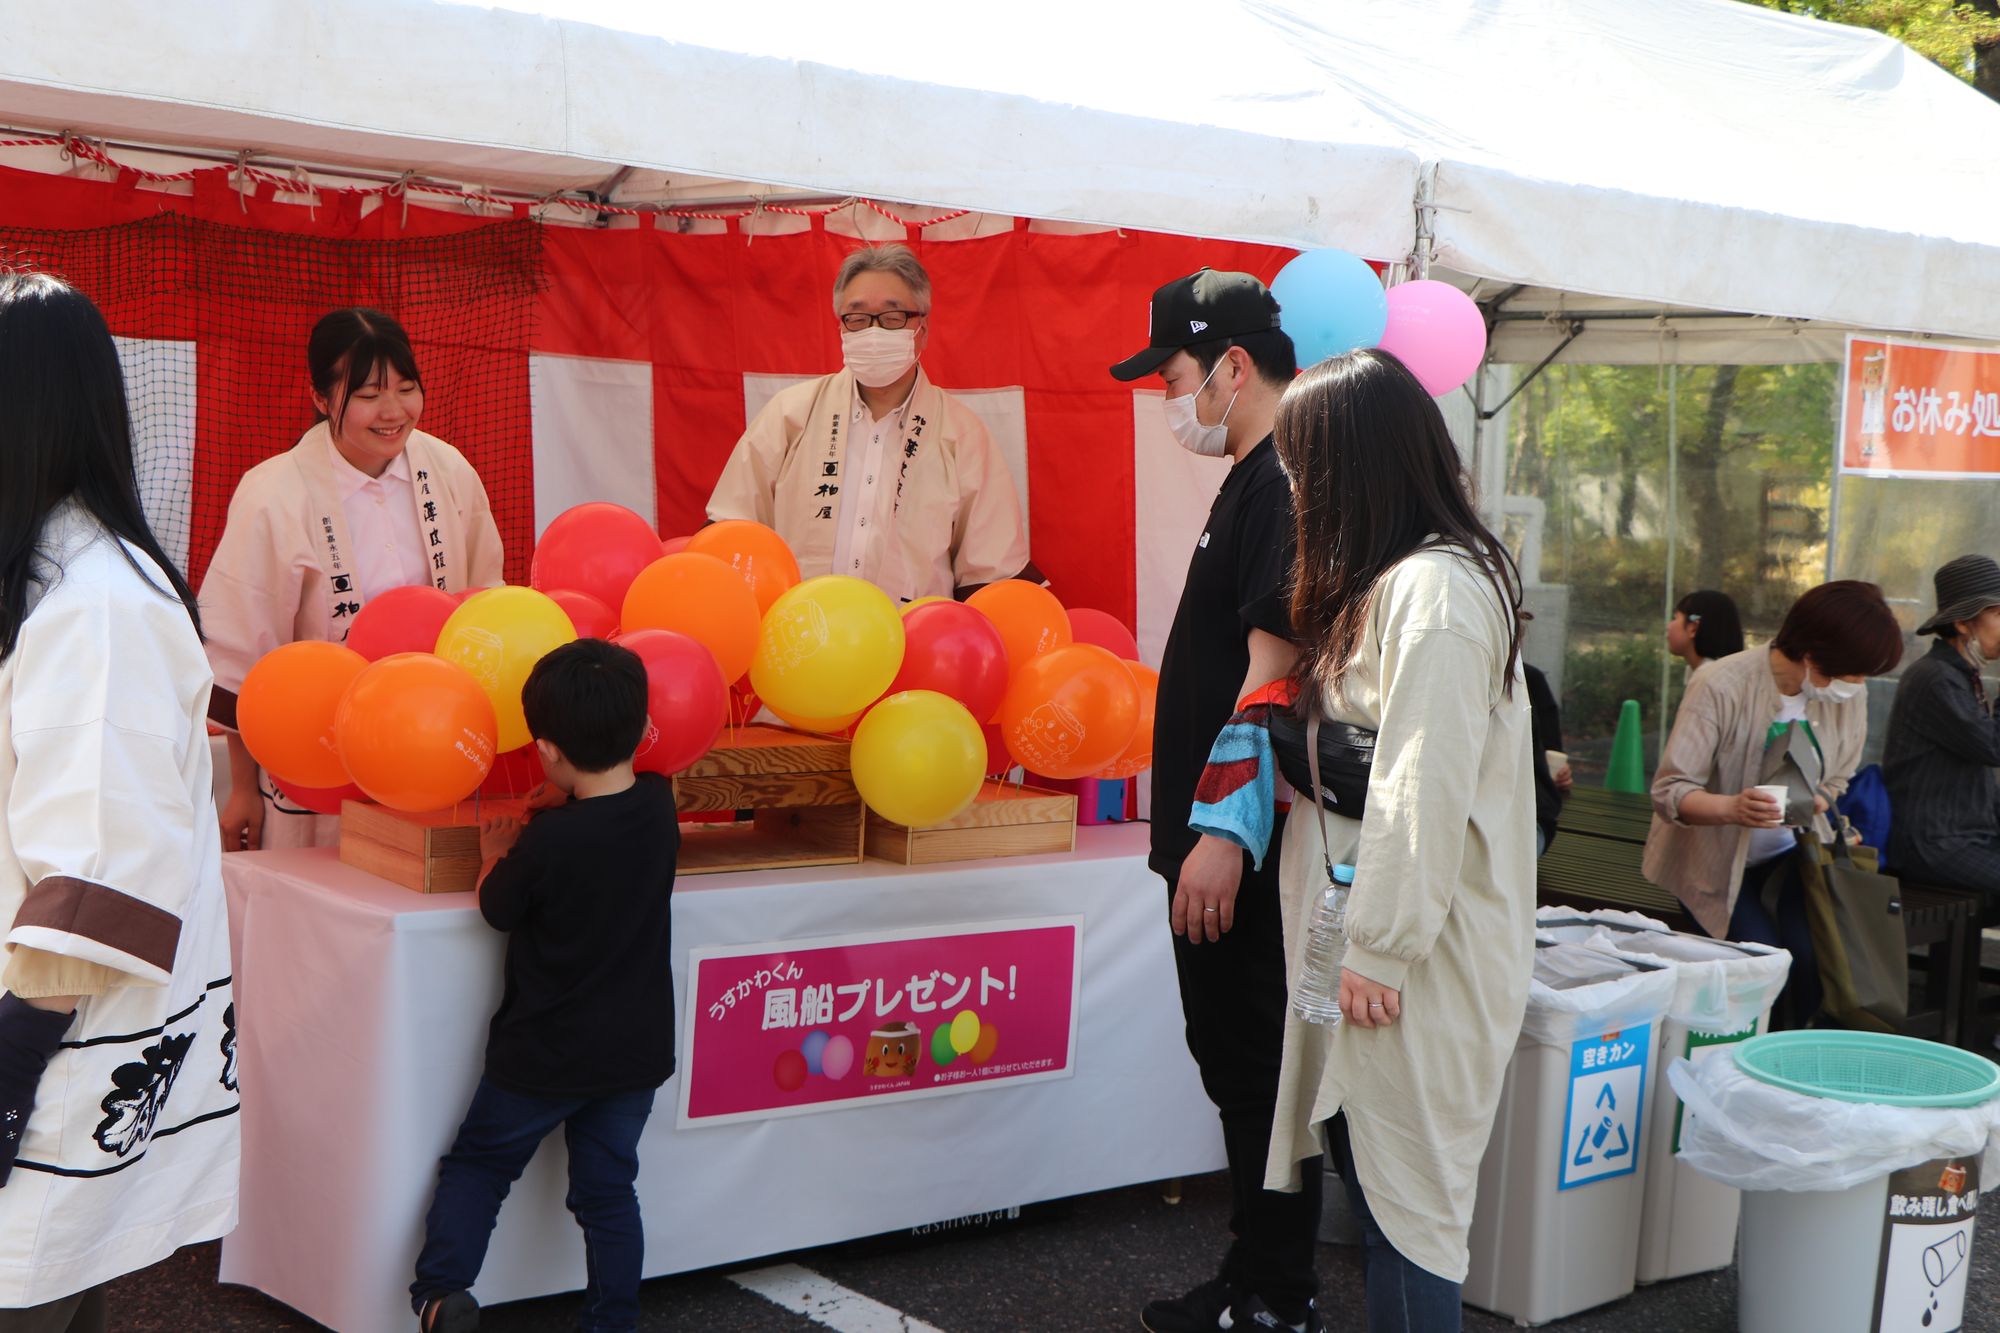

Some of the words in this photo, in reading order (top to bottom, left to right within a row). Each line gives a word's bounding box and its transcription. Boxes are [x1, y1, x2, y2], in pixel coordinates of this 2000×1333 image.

[1892, 386, 2000, 437] お休み処
[814, 484, 839, 519] 柏屋
[322, 516, 342, 570] 創業嘉永五年
[708, 960, 804, 1021] うすかわくん
[761, 965, 1017, 1031] 風船プレゼント!
[1582, 1042, 1636, 1069] 空きカン
